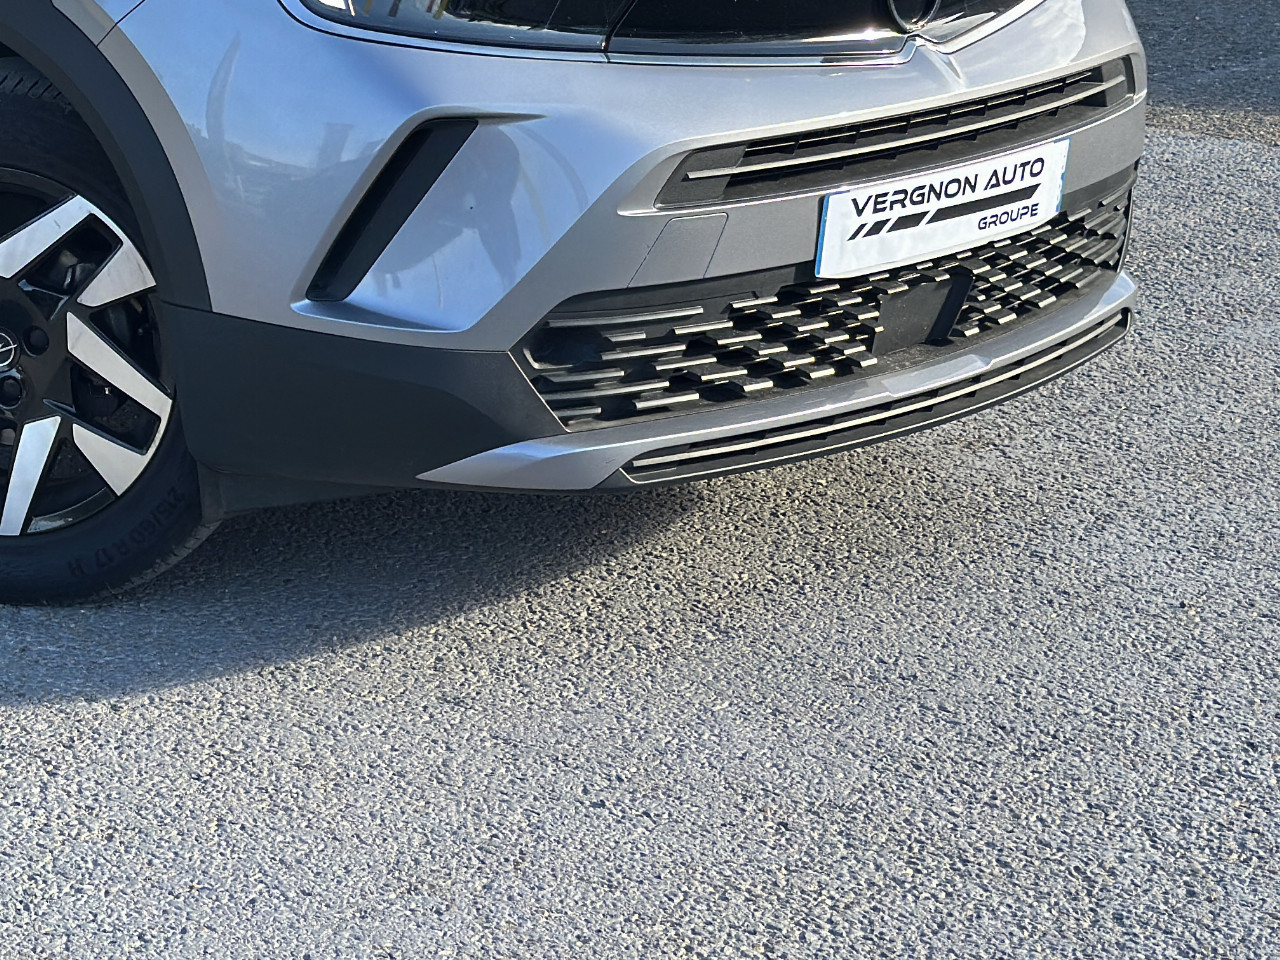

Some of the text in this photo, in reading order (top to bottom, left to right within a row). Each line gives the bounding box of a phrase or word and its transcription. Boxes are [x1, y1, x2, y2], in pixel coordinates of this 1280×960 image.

[851, 157, 1045, 217] VERGNON AUTO
[977, 203, 1040, 231] GROUPE
